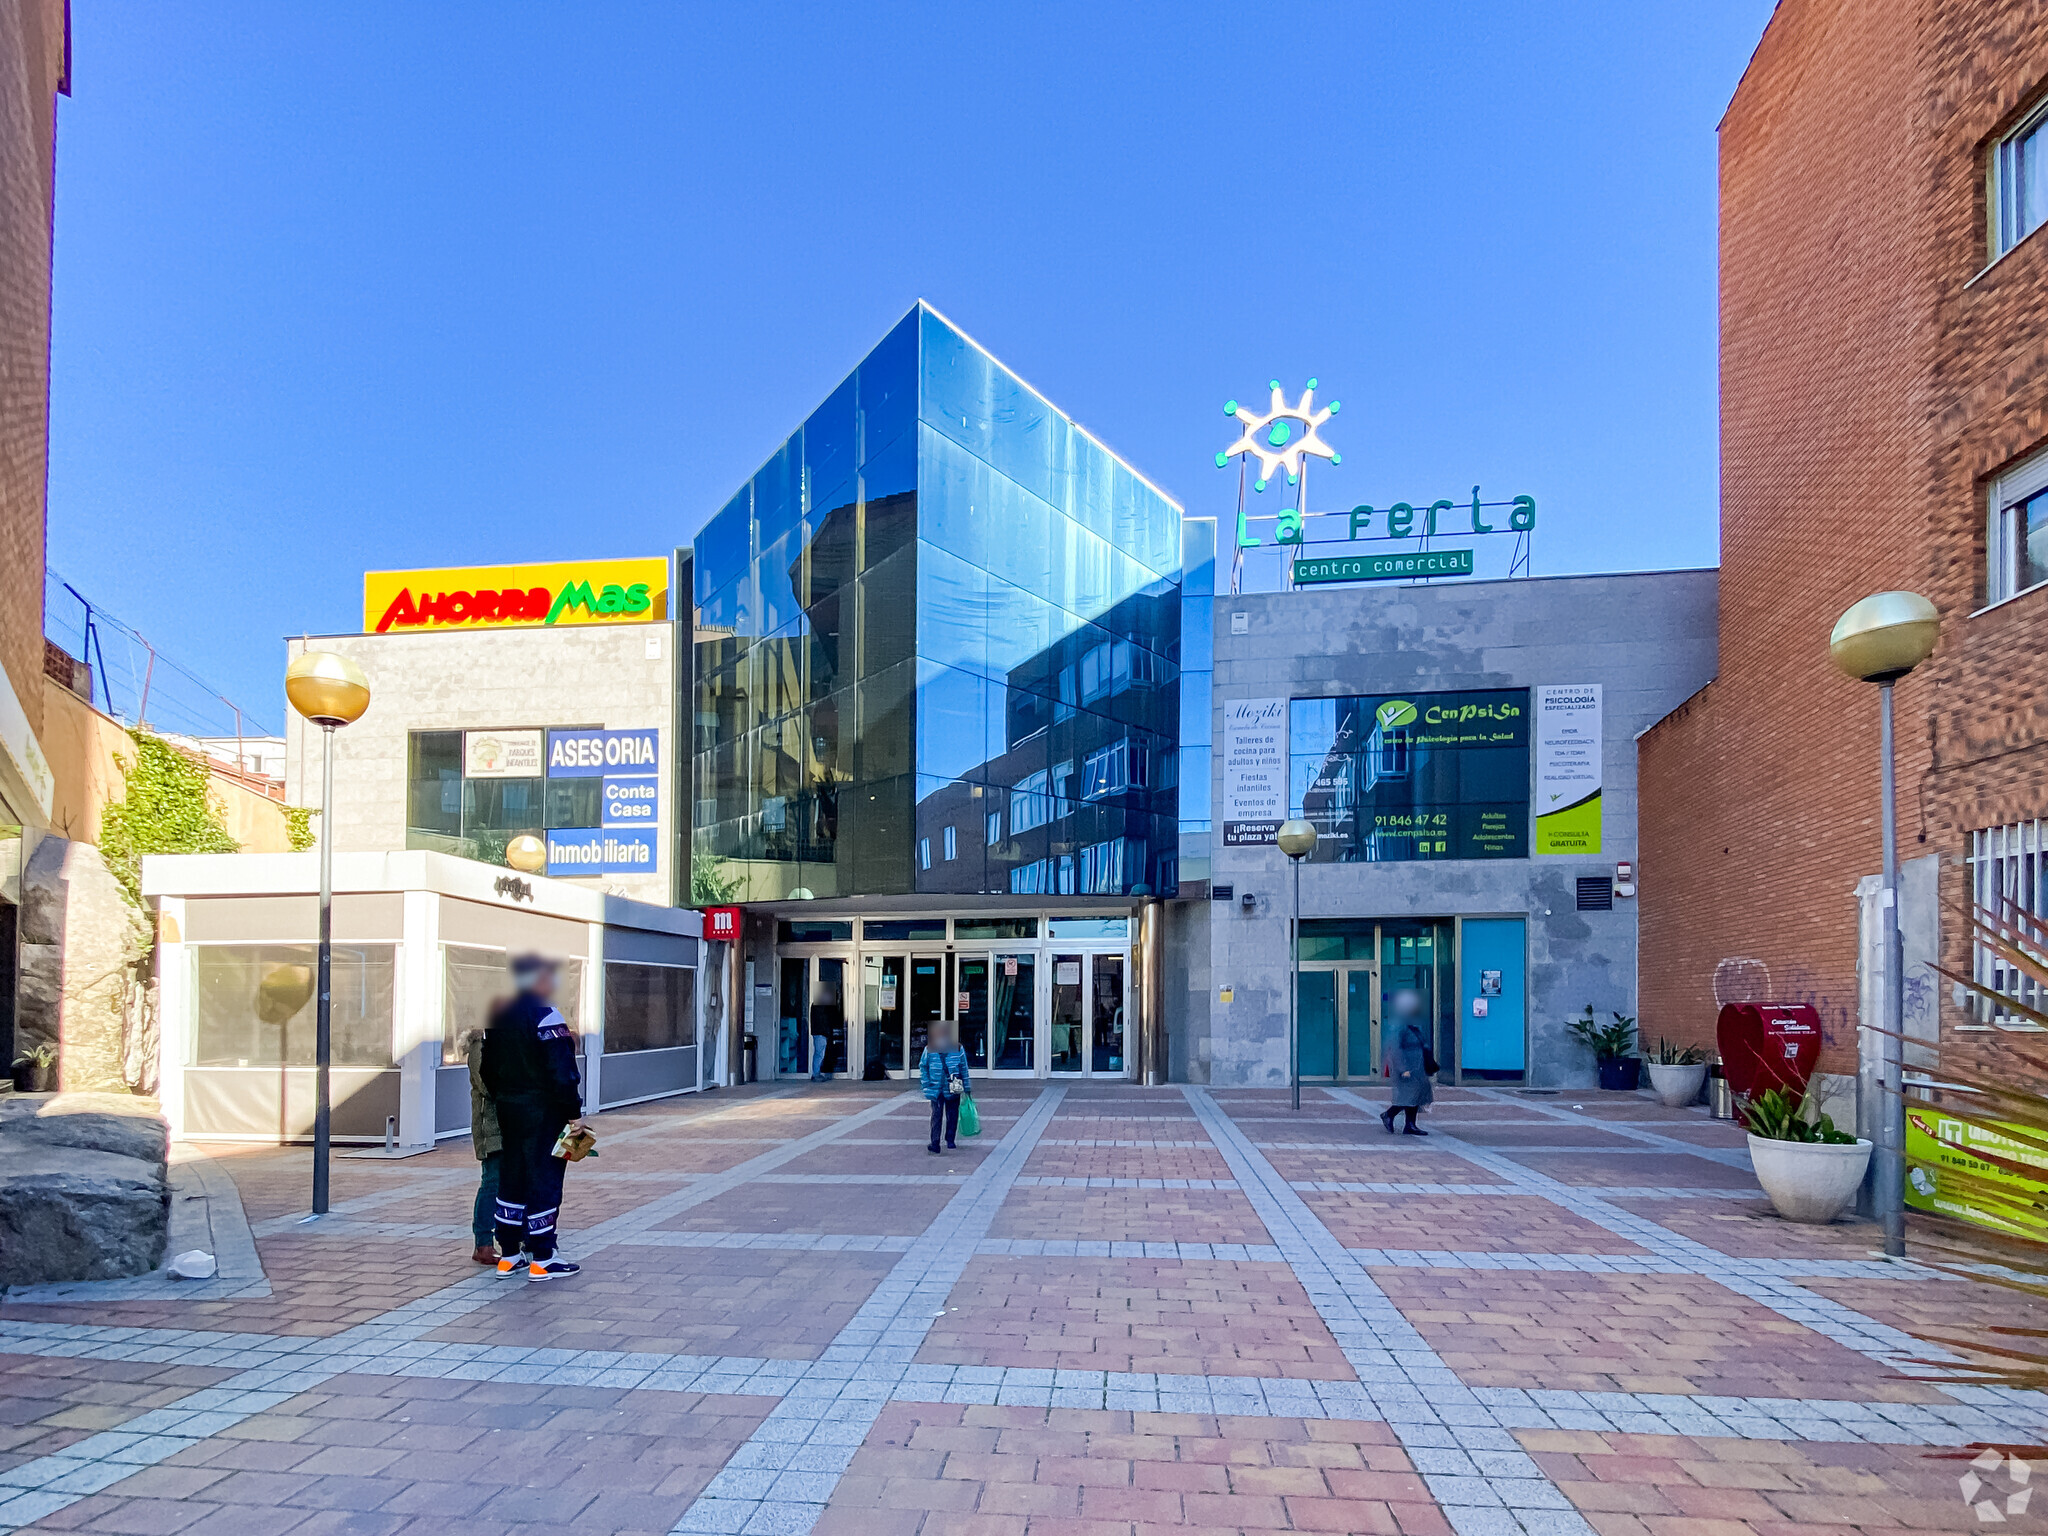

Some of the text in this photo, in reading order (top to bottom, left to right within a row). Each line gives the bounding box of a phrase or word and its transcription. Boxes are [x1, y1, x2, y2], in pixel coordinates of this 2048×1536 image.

[1299, 552, 1469, 578] centro comercial
[1546, 688, 1581, 696] CENTRO
[1545, 695, 1596, 704] PSICOLOGÍA
[1226, 702, 1284, 725] Moziki
[1235, 736, 1274, 745] Talleres de
[550, 736, 656, 768] ASESORIA
[1233, 747, 1276, 756] cocina para
[1227, 757, 1281, 767] adultos y niños
[1240, 773, 1268, 781] Fiestas
[605, 784, 656, 800] Conta
[1236, 783, 1272, 793] infantiles
[1234, 798, 1276, 807] Eventos de
[609, 802, 652, 818] Casa
[1238, 809, 1272, 818] empresa
[1375, 813, 1447, 826] 91 846 47 42
[1227, 833, 1237, 842] tu
[1239, 832, 1262, 843] plaza
[1550, 840, 1587, 848] GRATUITA
[549, 839, 650, 864] Inmobiliaria
